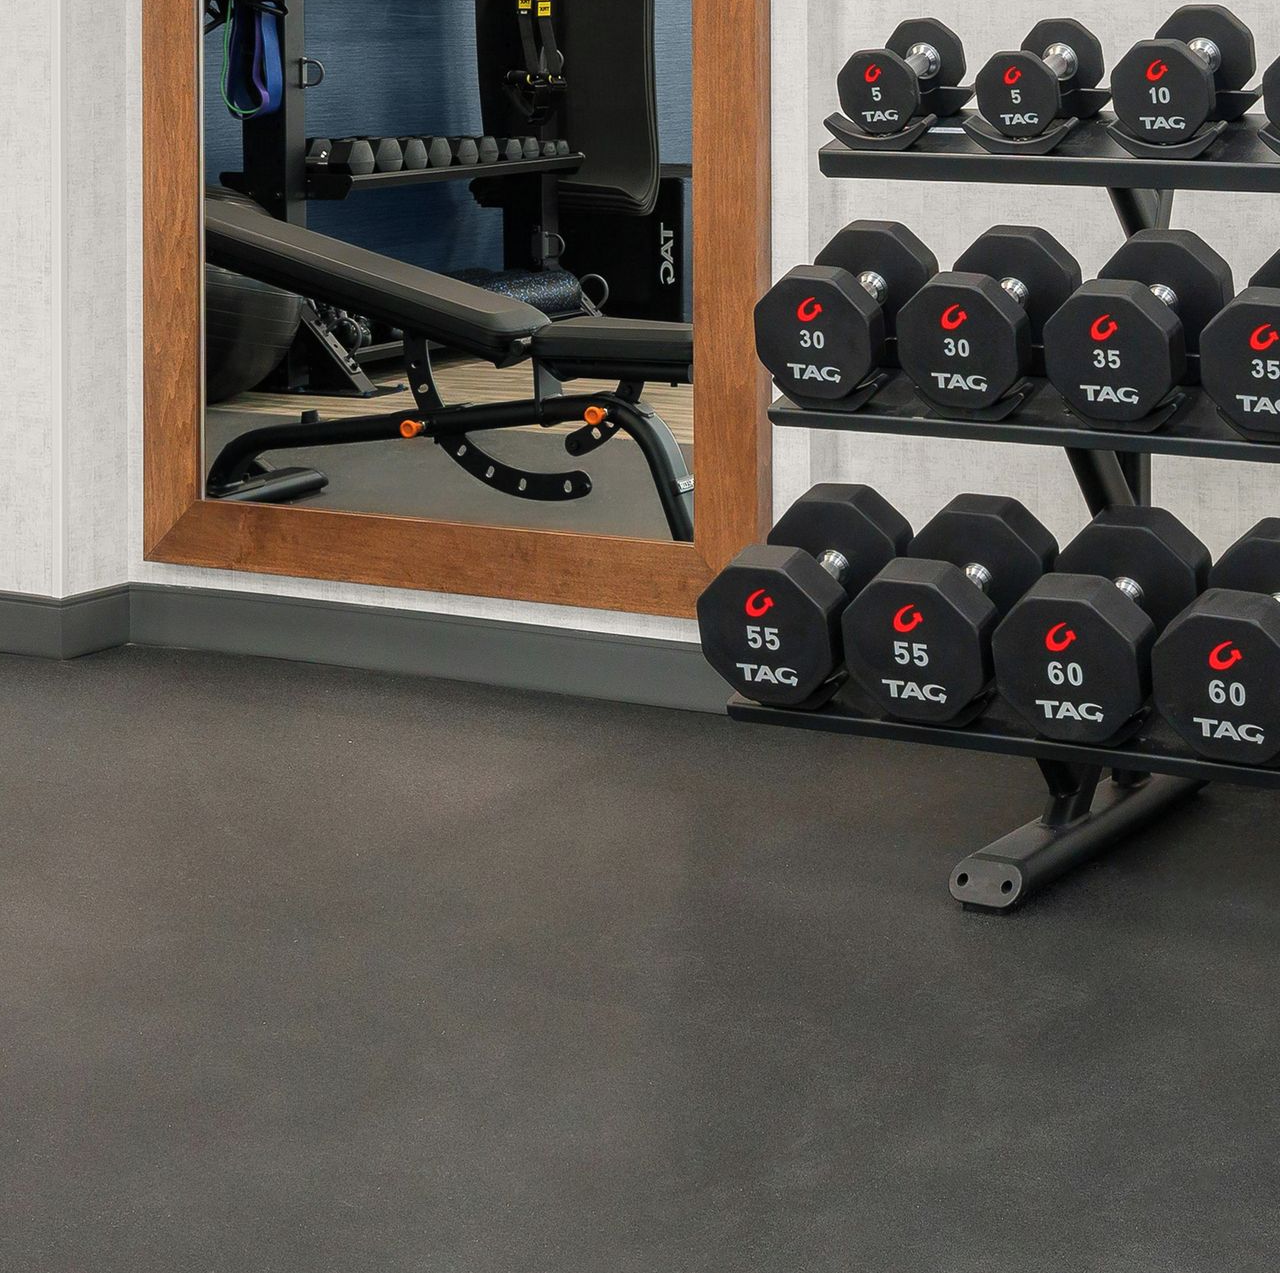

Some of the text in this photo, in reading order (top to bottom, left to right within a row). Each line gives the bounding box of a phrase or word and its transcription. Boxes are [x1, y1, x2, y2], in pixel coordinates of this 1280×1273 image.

[870, 85, 882, 103] 5
[1009, 88, 1022, 105] 5
[1148, 86, 1171, 104] 10
[860, 109, 899, 123] TAG
[999, 111, 1040, 125] TAG
[1137, 114, 1189, 133] TAG
[799, 329, 825, 349] 30
[943, 337, 970, 358] 30
[1092, 349, 1121, 369] 35
[1251, 358, 1280, 380] 35
[785, 361, 843, 385] TAG
[929, 371, 989, 393] TAG
[1078, 383, 1141, 406] TAG
[746, 625, 781, 651] 55
[893, 640, 929, 667] 55
[734, 661, 800, 688] TAG
[1047, 661, 1083, 687] 60
[880, 677, 949, 705] TAG
[1208, 679, 1246, 707] 60
[1034, 698, 1105, 724] TAG
[1191, 716, 1266, 746] TAG
